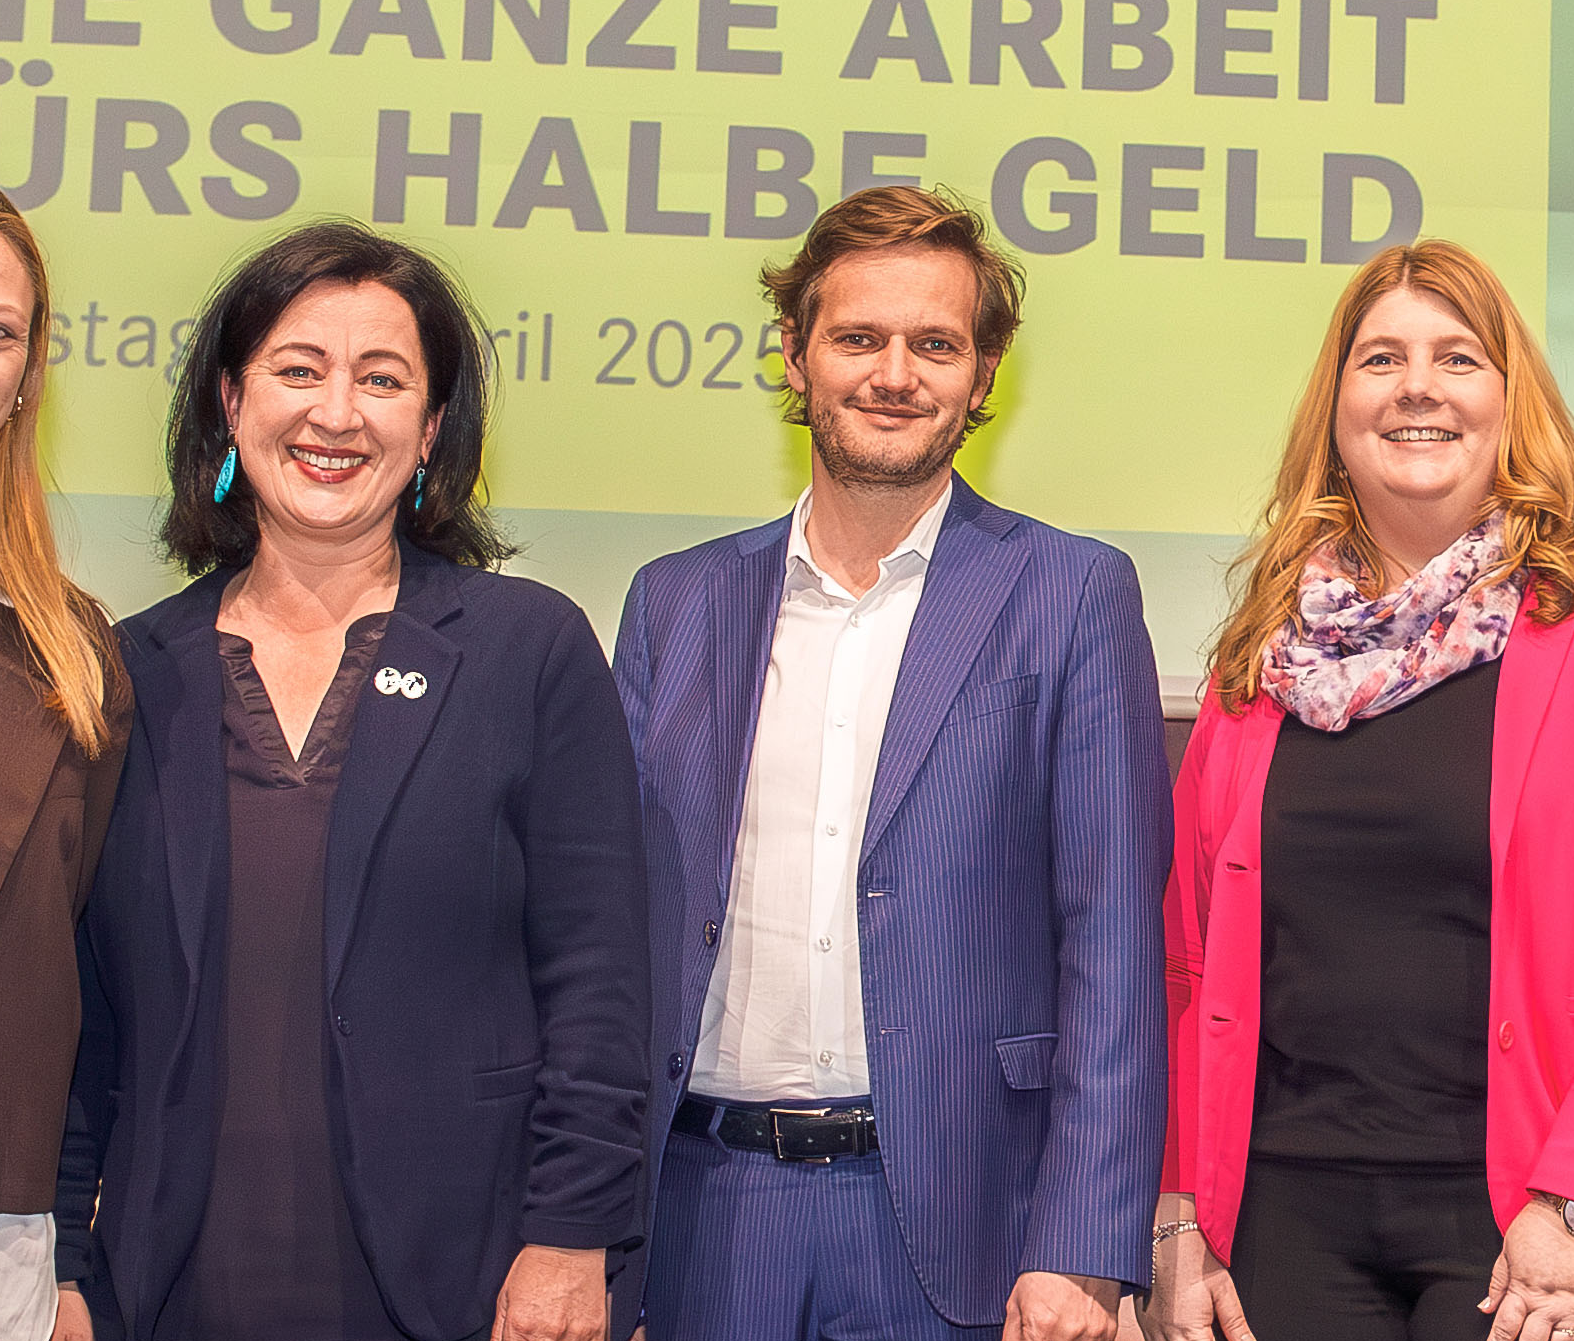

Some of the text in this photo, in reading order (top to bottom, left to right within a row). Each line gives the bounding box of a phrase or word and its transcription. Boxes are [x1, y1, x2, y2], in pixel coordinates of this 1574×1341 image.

[371, 109, 928, 240] HALBE
[990, 136, 1425, 265] GELD
[487, 310, 554, 383] ril
